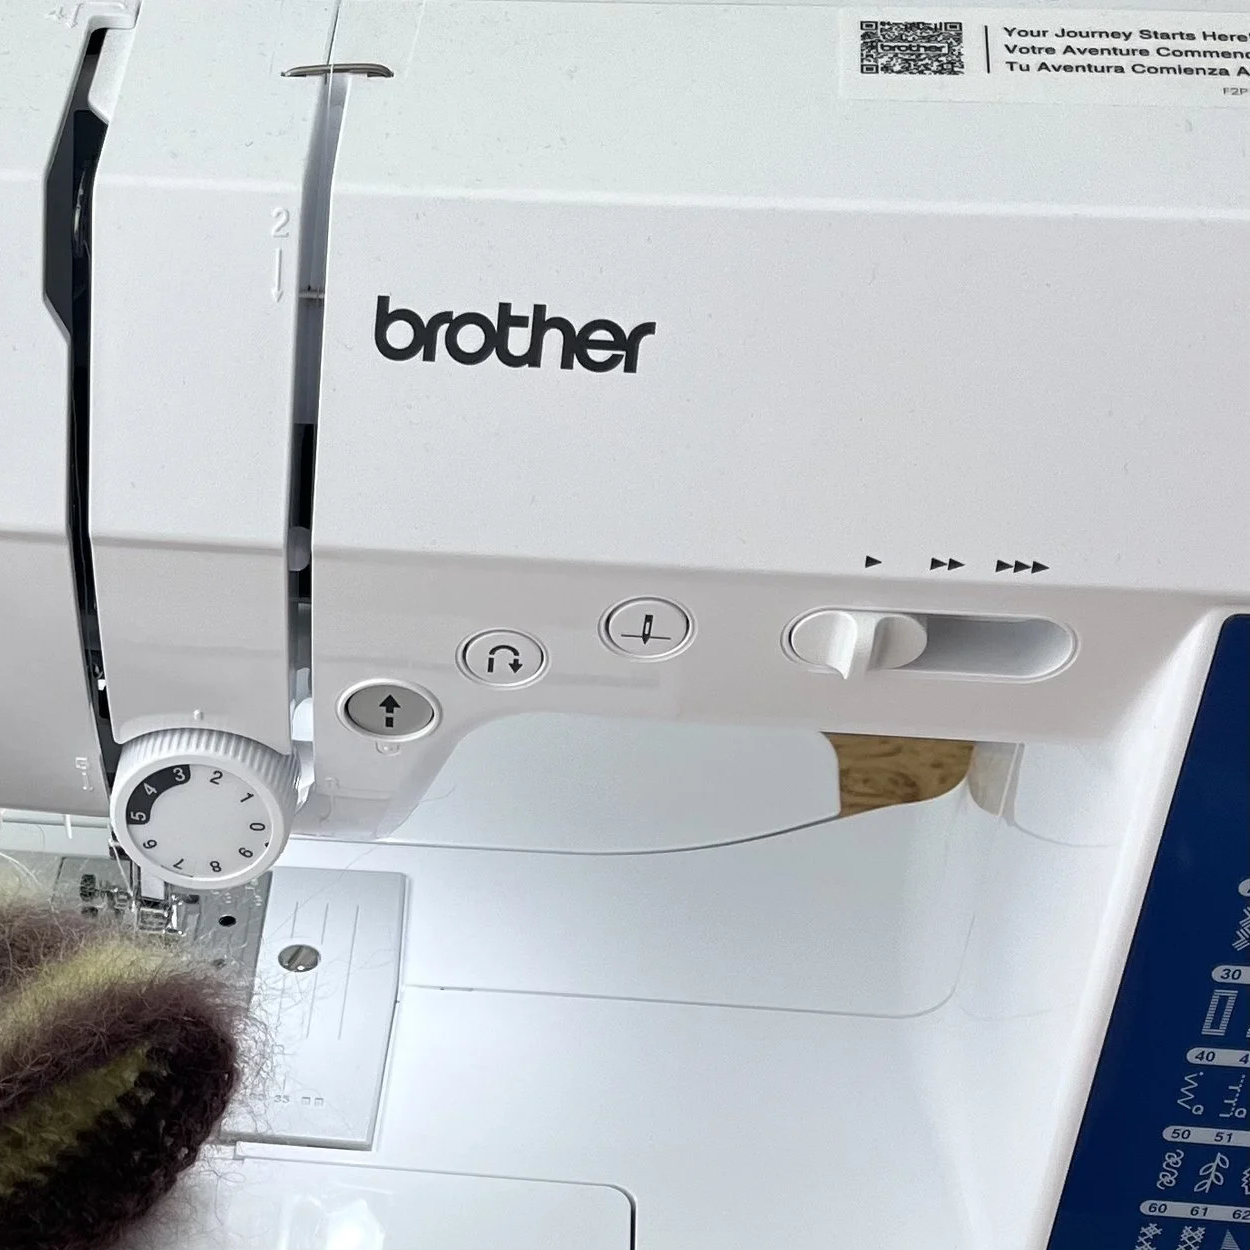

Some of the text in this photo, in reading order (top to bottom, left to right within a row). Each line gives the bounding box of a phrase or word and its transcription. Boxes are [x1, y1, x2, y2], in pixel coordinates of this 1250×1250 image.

[1003, 26, 1049, 38] Your
[1054, 27, 1133, 42] Journey
[1138, 29, 1197, 41] Starts
[1004, 43, 1056, 55] Votre
[1062, 44, 1150, 57] Aventure
[1005, 60, 1030, 72] Tu
[1037, 61, 1126, 74] Aventura
[1131, 63, 1230, 77] Comienza
[270, 206, 291, 239] 2
[374, 294, 657, 374] brother
[130, 767, 266, 873] 0 1 2 3 4 5 6 7 8 9
[1220, 968, 1242, 981] 30
[1194, 1050, 1216, 1063] 40
[1170, 1128, 1234, 1144] 50 51
[1148, 1202, 1250, 1221] 60 61 62
